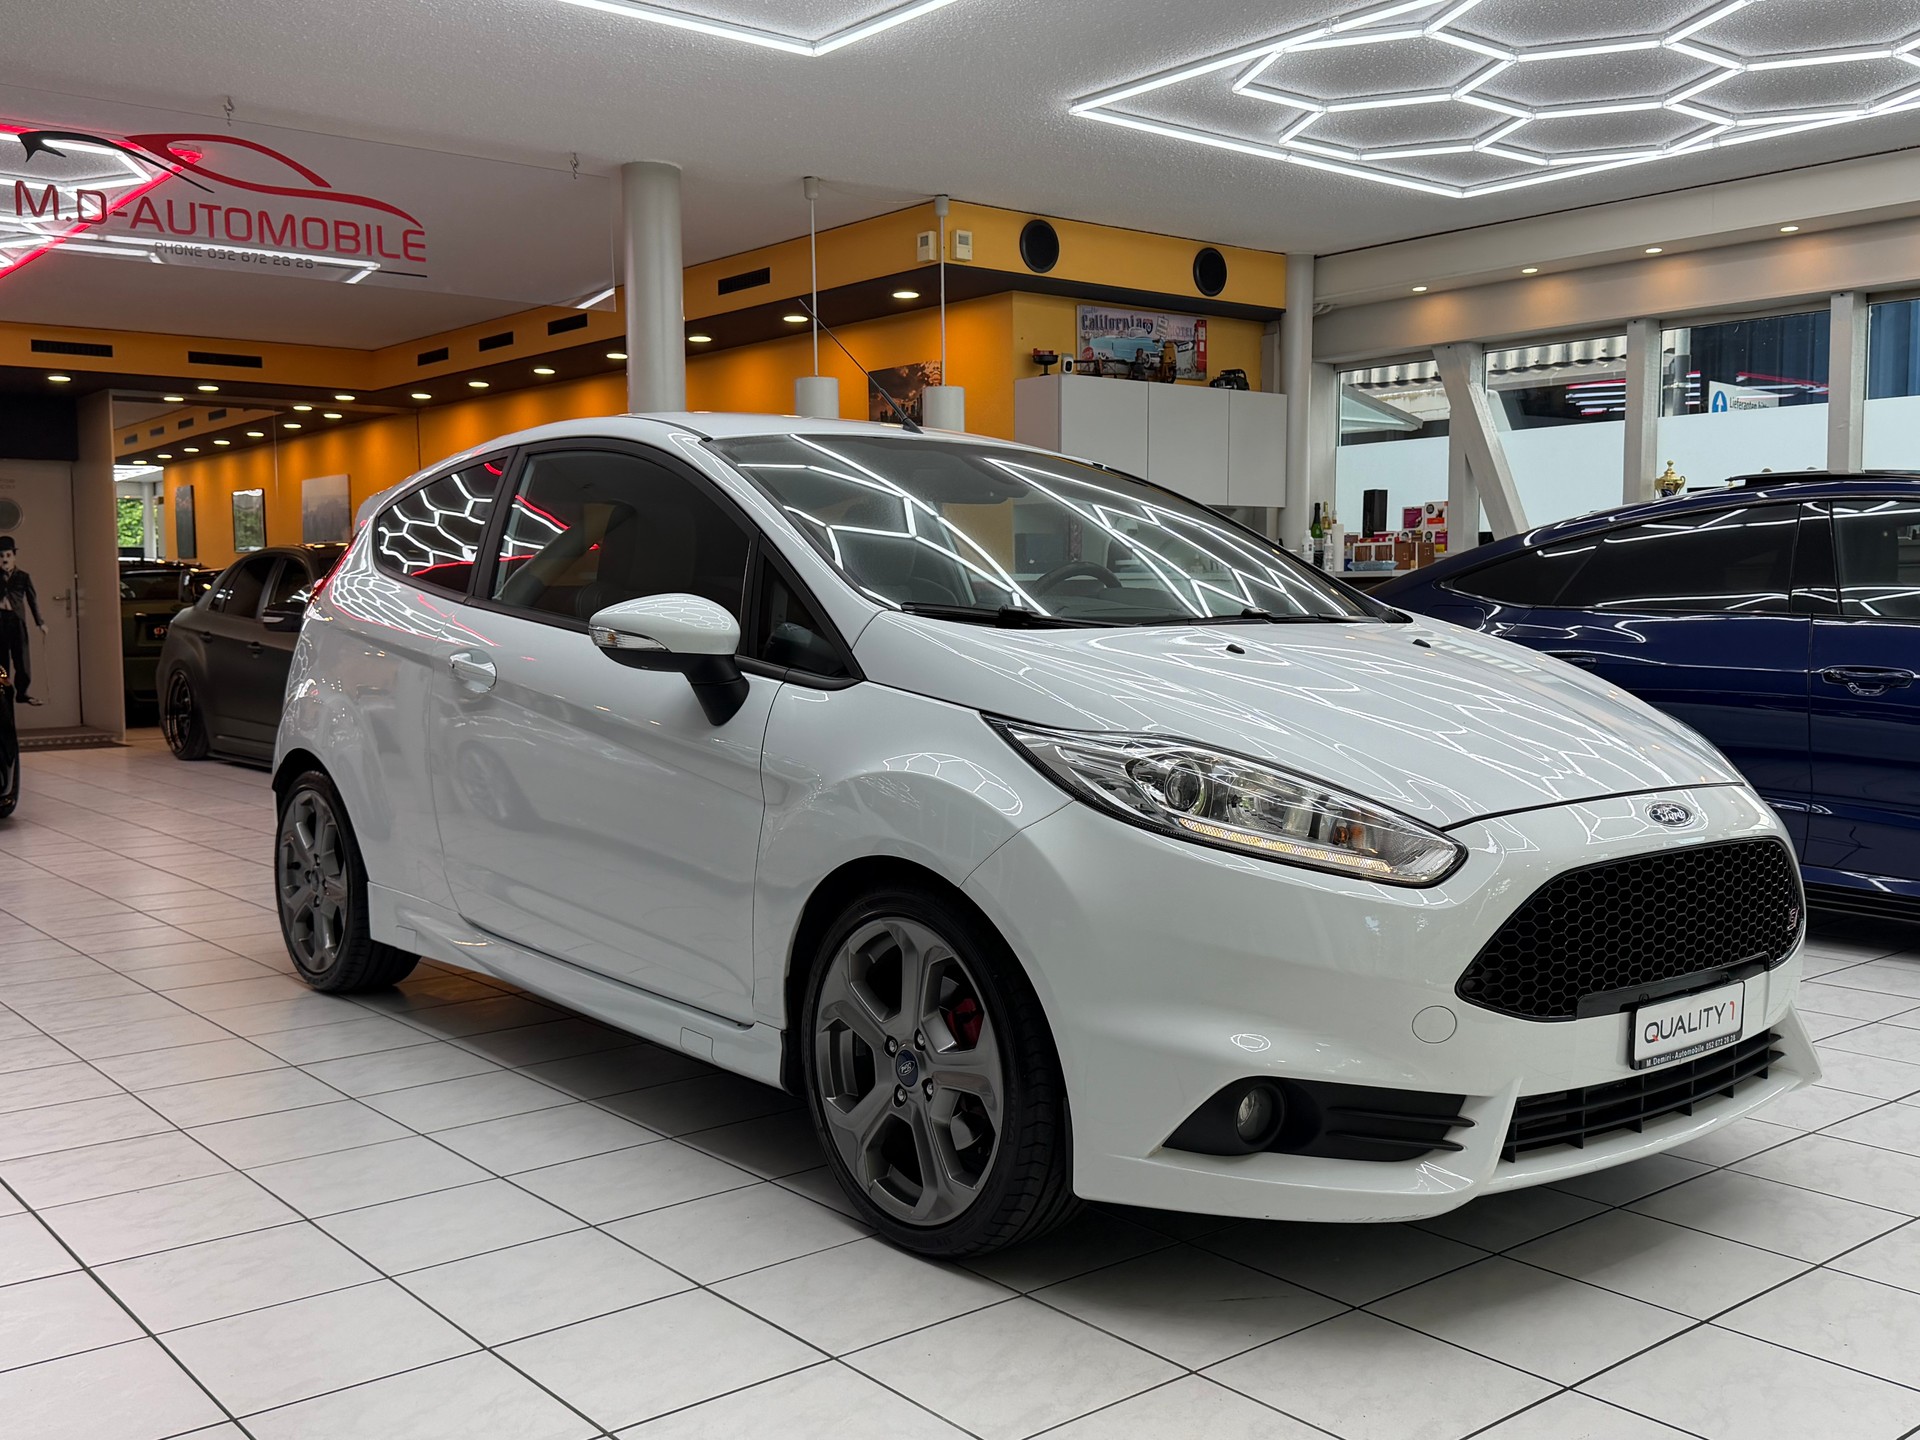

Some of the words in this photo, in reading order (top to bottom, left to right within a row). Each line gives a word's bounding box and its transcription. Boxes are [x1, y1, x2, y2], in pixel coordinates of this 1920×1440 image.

[15, 180, 427, 263] M.D-AUTOMOBILE
[154, 242, 203, 258] PHONE
[207, 248, 236, 261] 052
[1081, 314, 1143, 331] California
[1644, 1002, 1727, 1044] QUALITY
